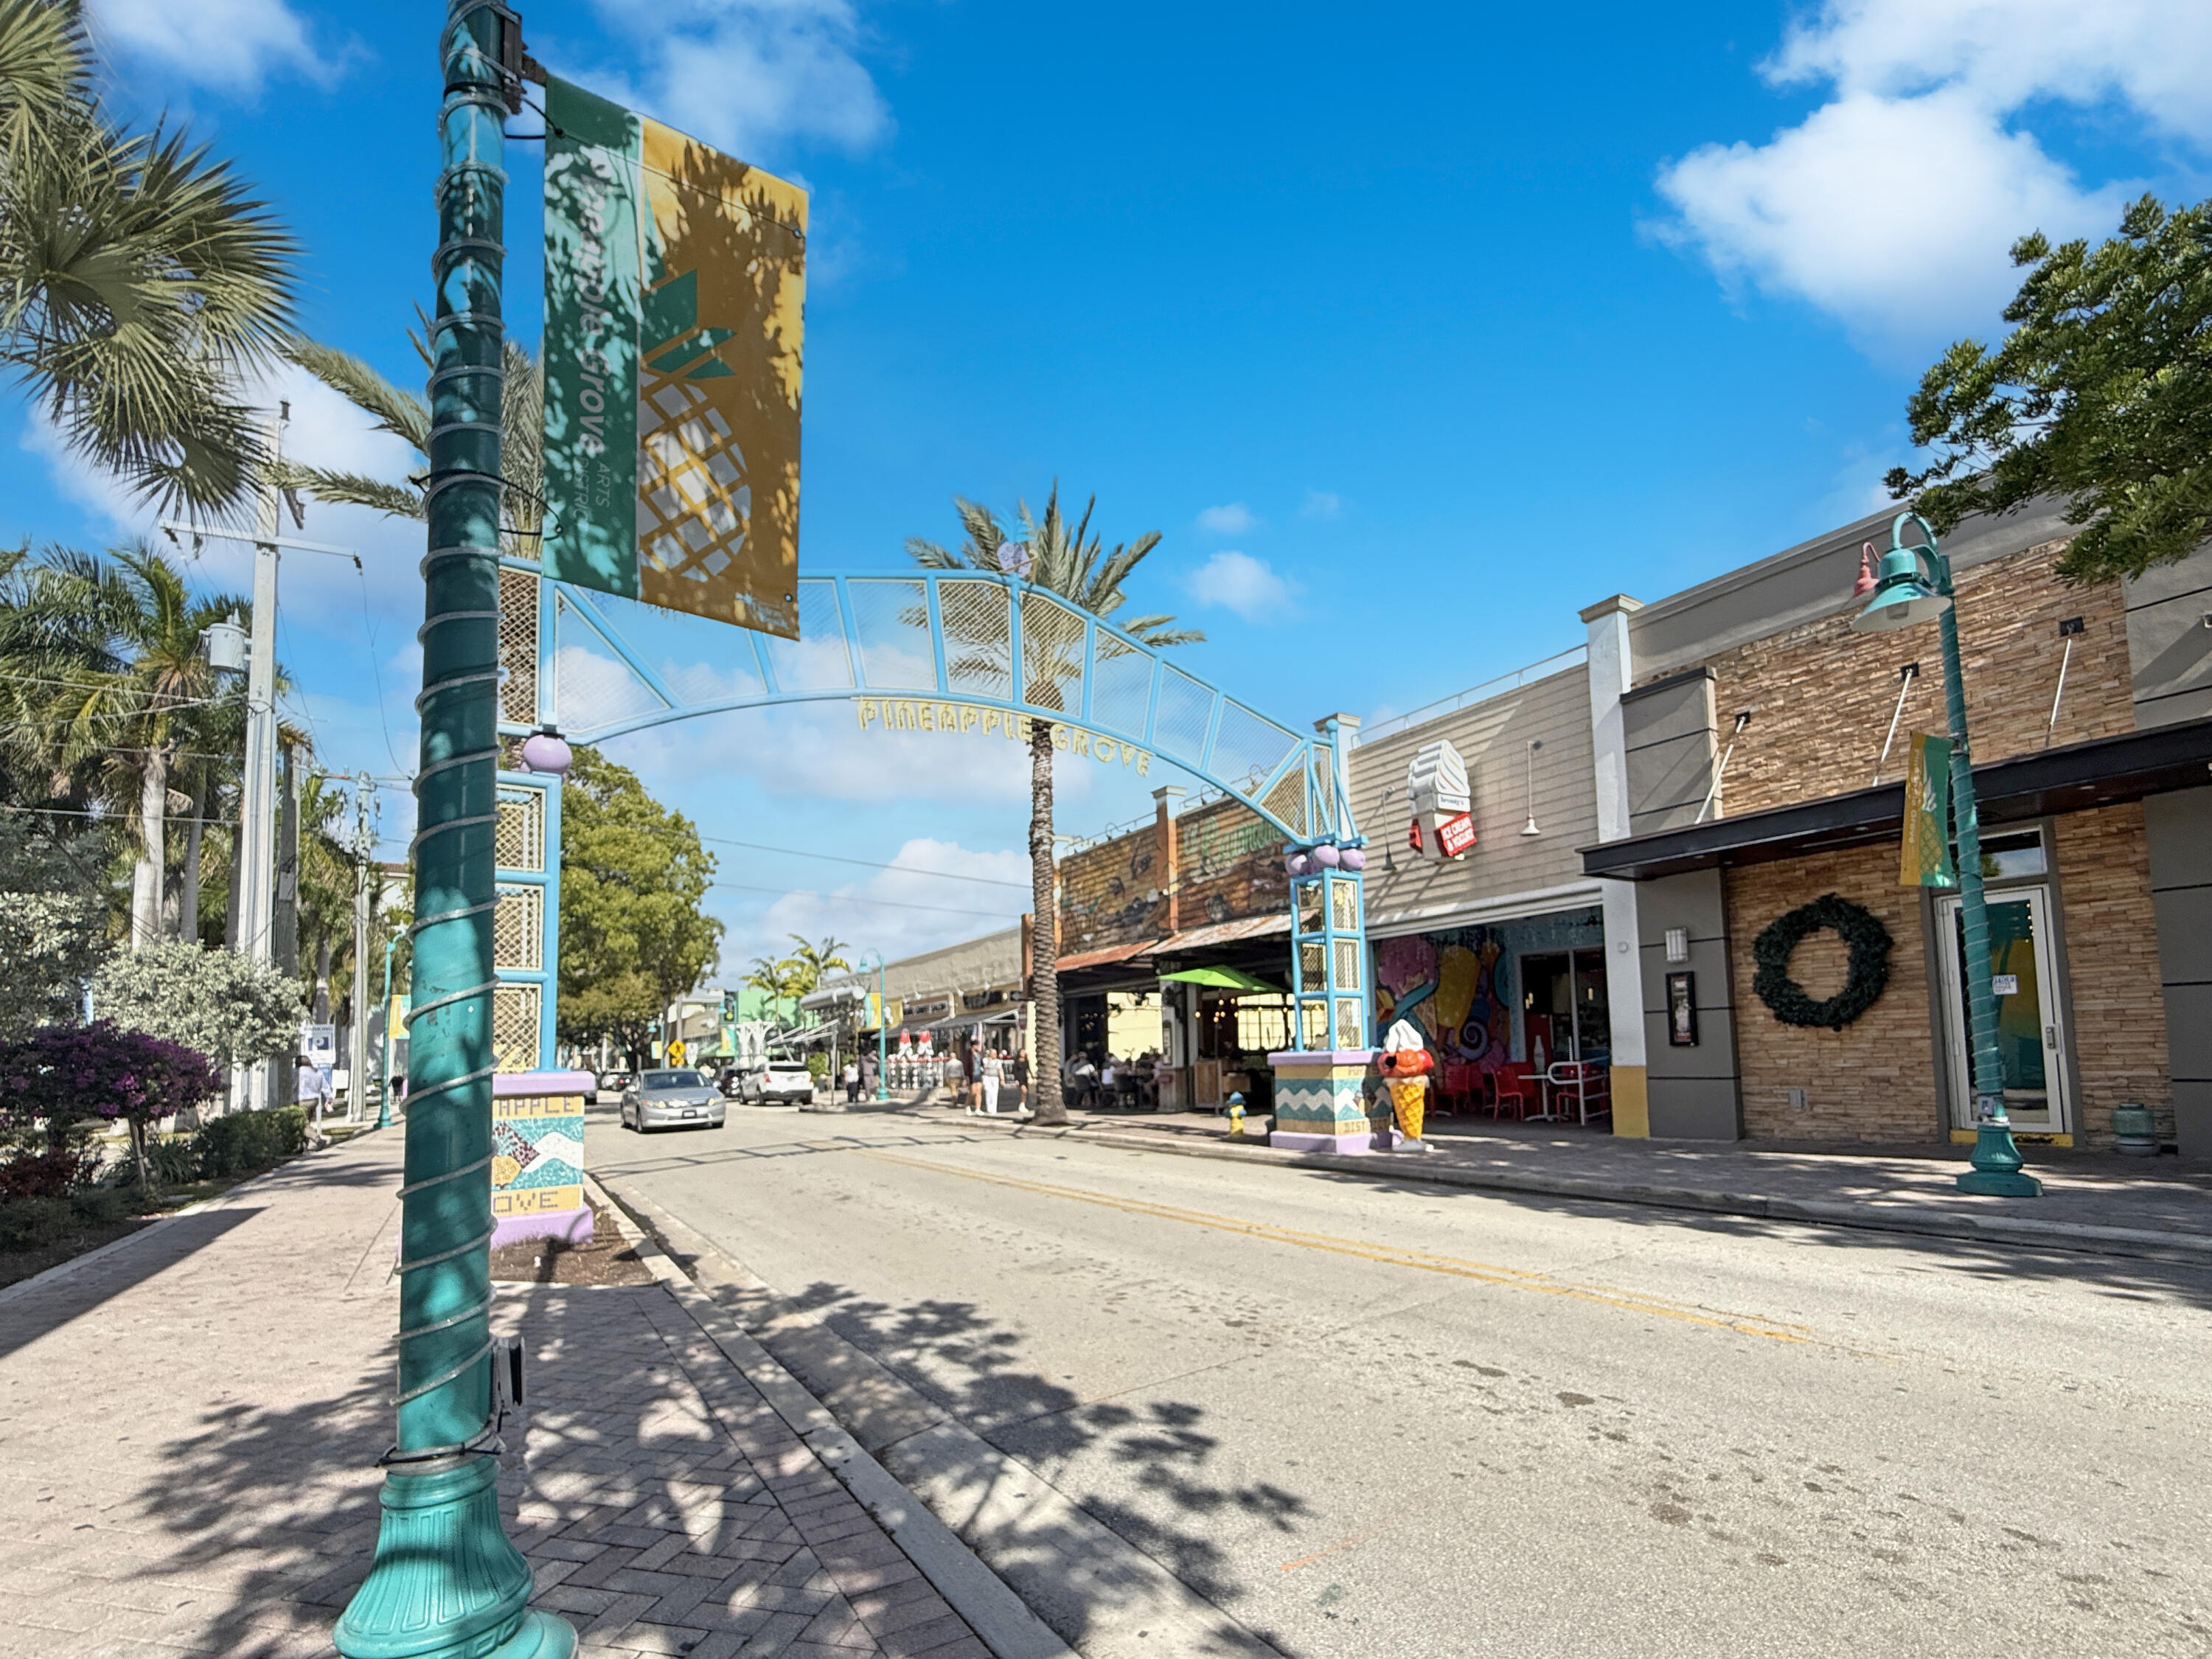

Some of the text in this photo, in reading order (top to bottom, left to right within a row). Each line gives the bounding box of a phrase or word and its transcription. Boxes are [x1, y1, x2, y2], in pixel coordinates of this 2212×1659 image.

[572, 145, 613, 453] Pineapple Grove
[595, 461, 611, 507] ARTS
[858, 700, 1154, 776] PINEAPPLE GROVE
